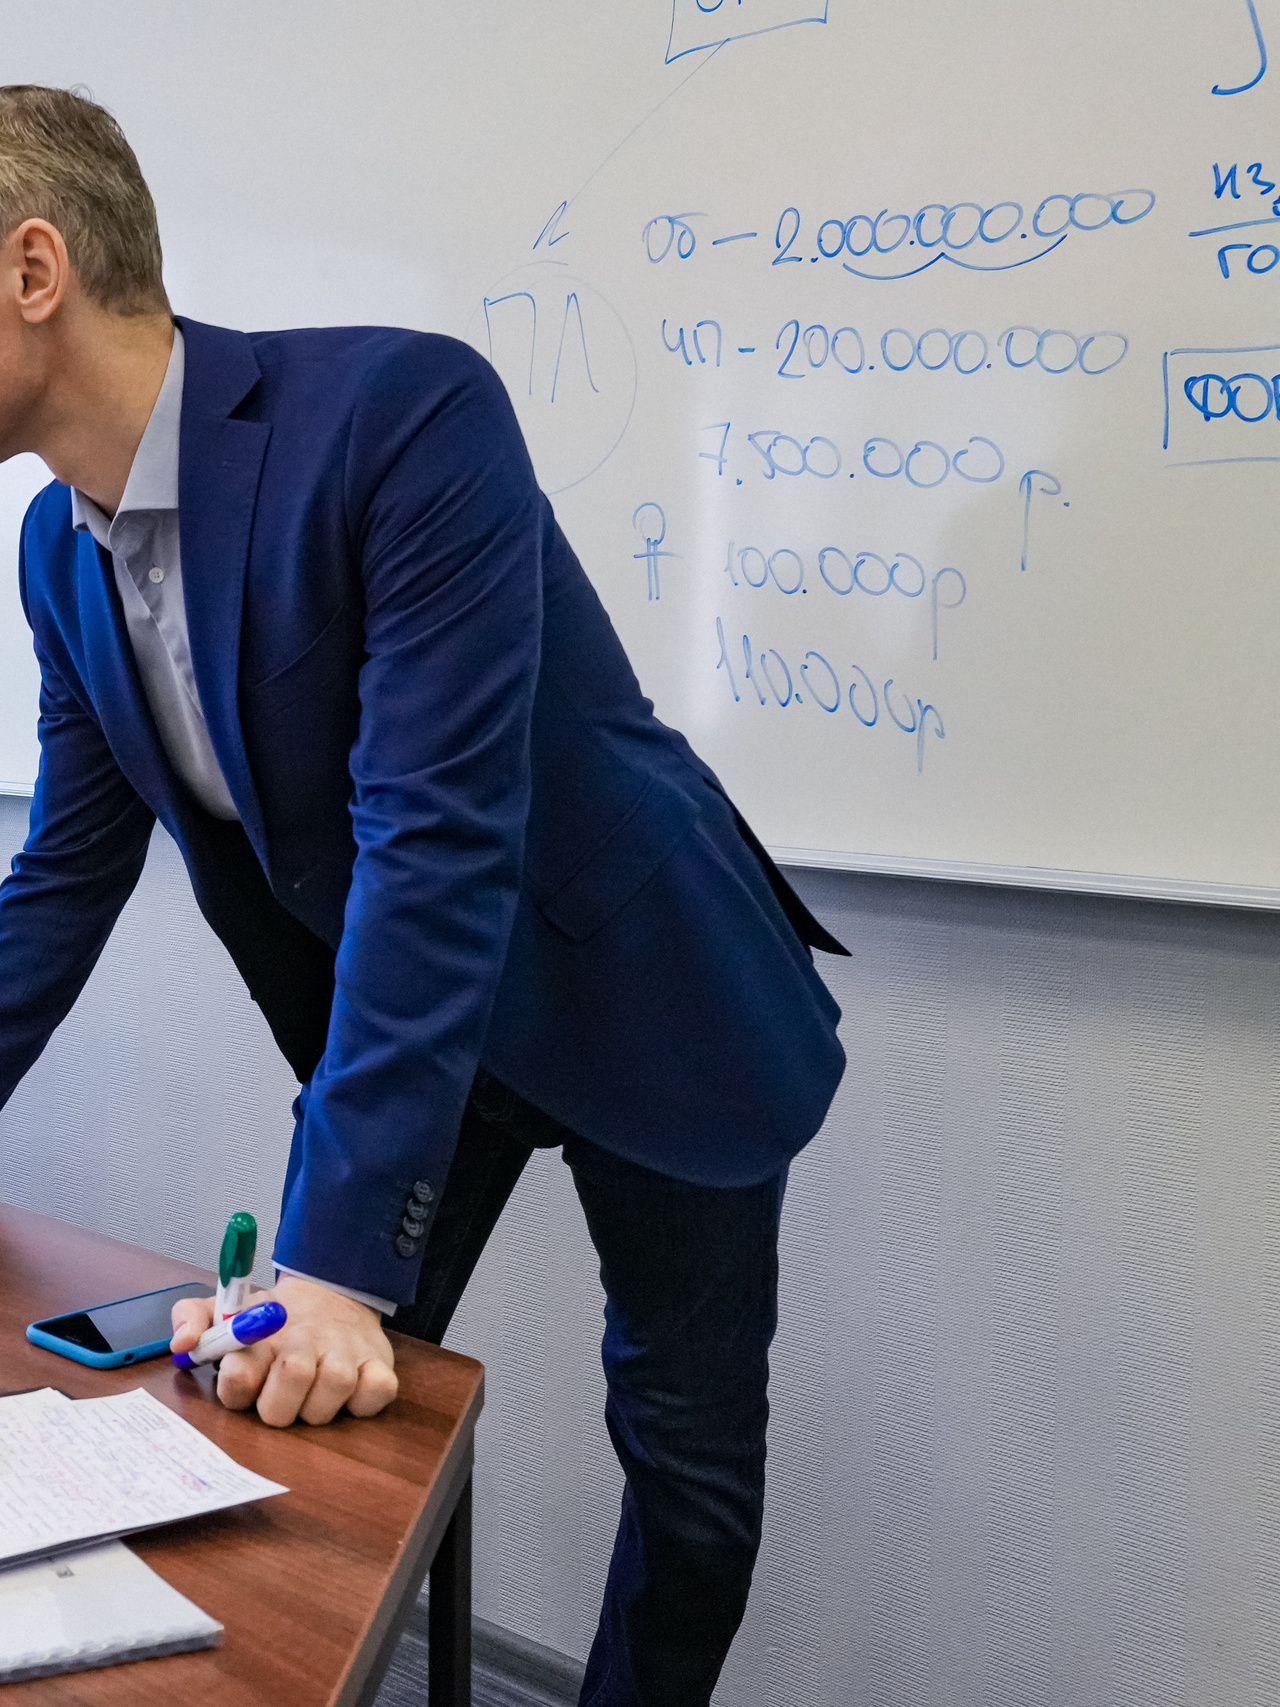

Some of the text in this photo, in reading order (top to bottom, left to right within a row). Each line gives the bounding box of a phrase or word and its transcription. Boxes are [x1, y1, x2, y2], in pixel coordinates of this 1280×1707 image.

[1212, 162, 1280, 216] ИЗ
[775, 318, 1130, 379] 200.000.000
[1183, 372, 1280, 423] ФО
